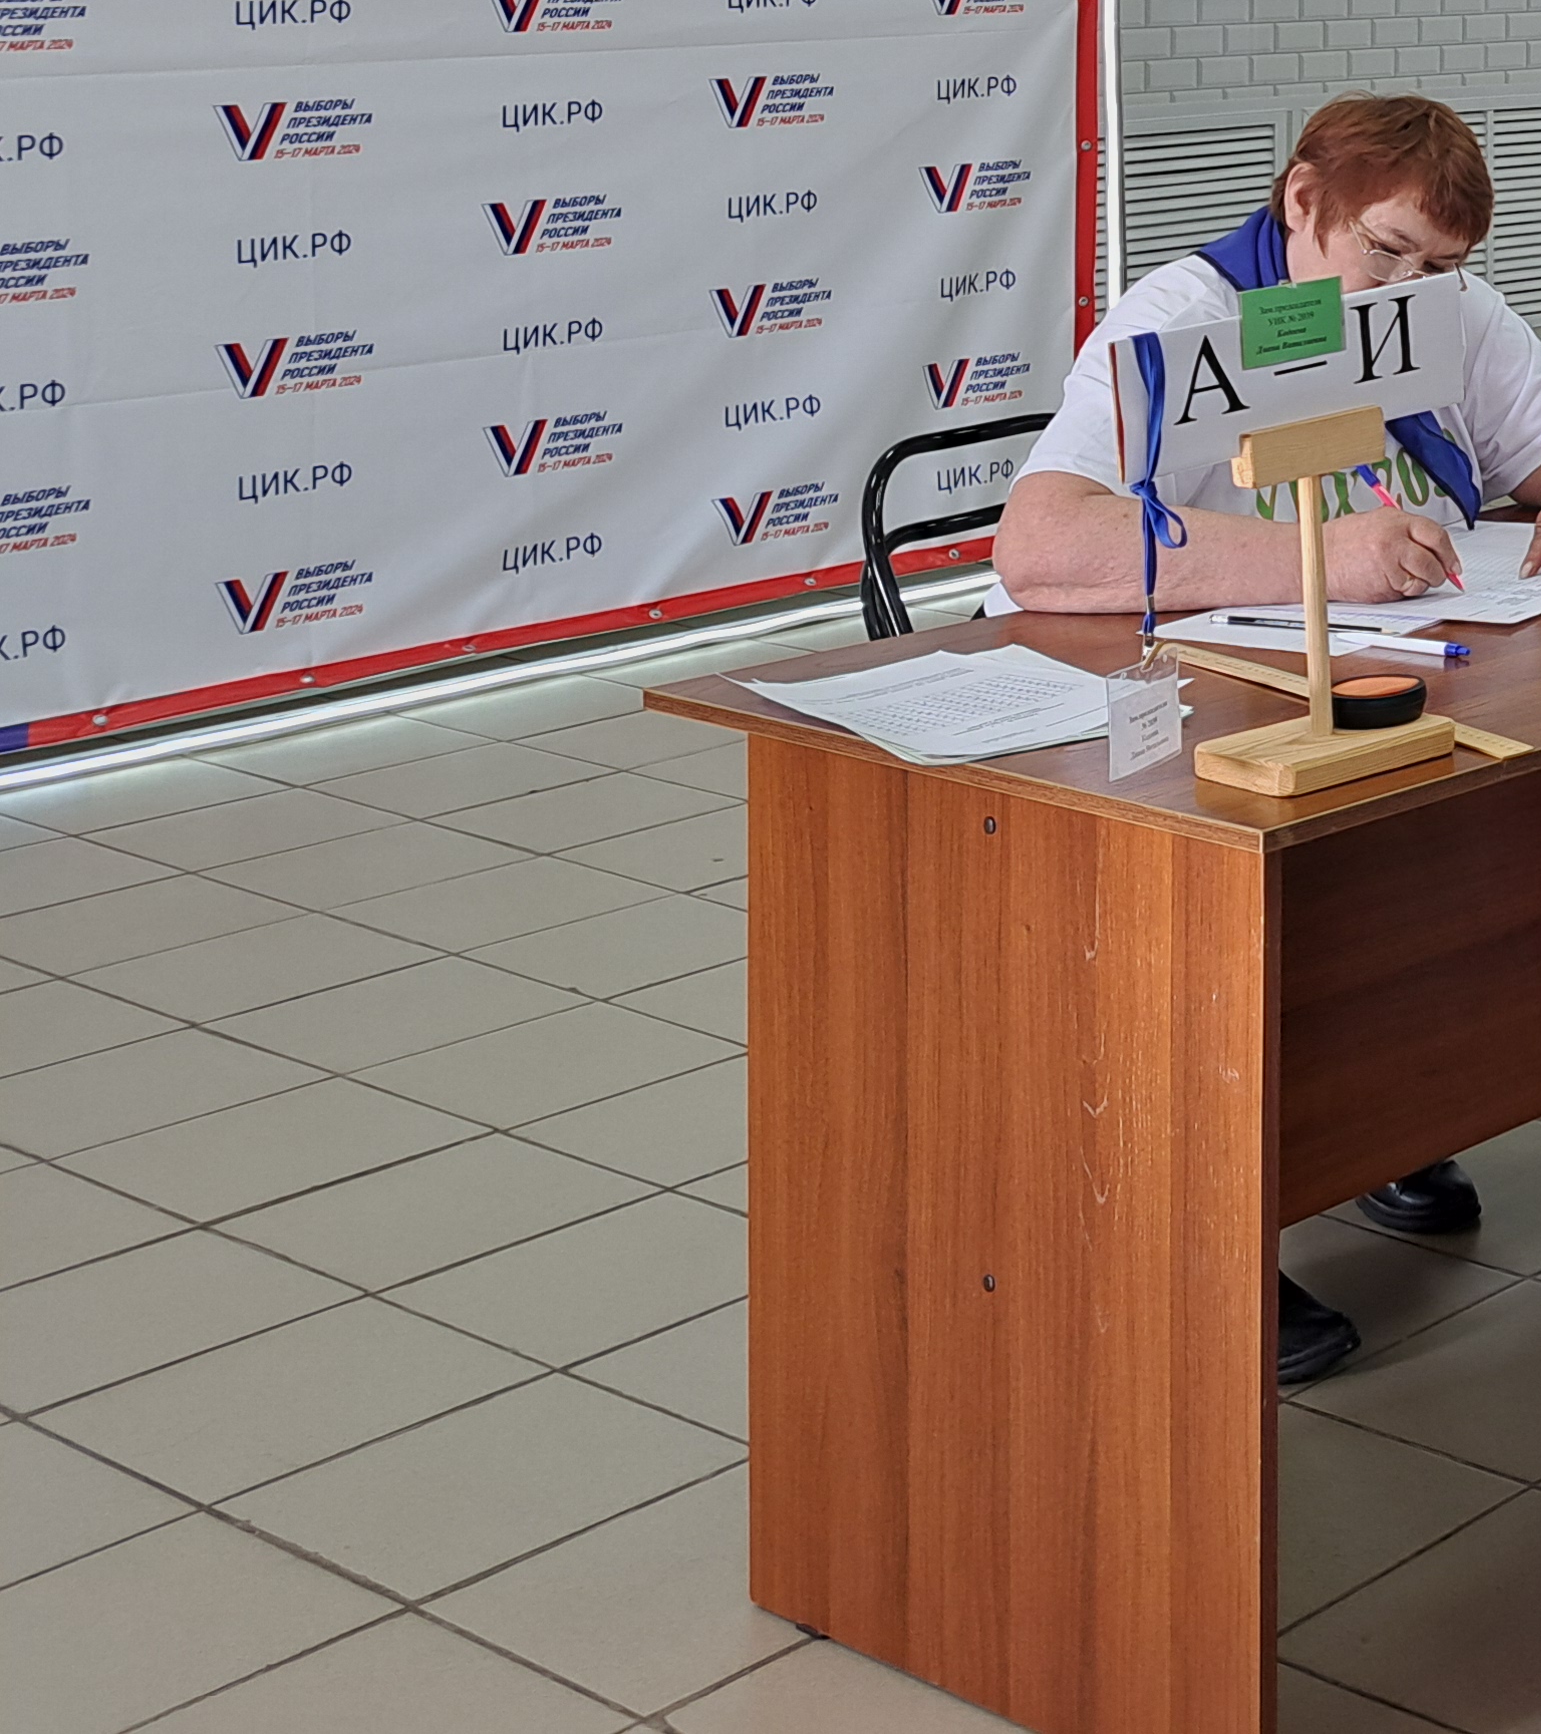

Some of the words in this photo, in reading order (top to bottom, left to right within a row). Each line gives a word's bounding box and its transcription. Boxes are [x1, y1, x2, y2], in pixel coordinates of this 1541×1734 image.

[541, 7, 590, 18] РОССИИ
[772, 73, 820, 85] ВЫБОРЫ
[766, 87, 834, 99] ПРЕЗИДЕНТА
[937, 75, 1016, 104] ЦИК.РФ
[294, 99, 354, 112] ВЫБОРЫ
[761, 102, 804, 114] РОССИИ
[287, 113, 372, 128] ПРЕЗИДЕНТА
[503, 99, 602, 132] ЦИК.РФ
[280, 131, 335, 144] РОССИИ
[977, 159, 1022, 172] ВЫБОРЫ
[974, 172, 1031, 185] ПРЕЗИДЕНТА
[552, 194, 606, 208] ВЫБОРЫ
[969, 187, 1009, 199] РОССИИ
[728, 190, 817, 222] ЦИК.РФ
[546, 208, 622, 224] ПРЕЗИДЕНТА
[540, 225, 589, 239] РОССИИ
[0, 238, 70, 256] ВЫБОРЫ
[238, 230, 351, 268] ЦИК.РФ
[771, 278, 818, 293] ВЫБОРЫ
[941, 269, 1016, 302] ЦИК.РФ
[766, 290, 831, 307] ПРЕЗИДЕНТА
[760, 307, 803, 321] РОССИИ
[295, 330, 356, 347] ВЫБОРЫ
[503, 318, 602, 355] ЦИК.РФ
[288, 344, 374, 363] ПРЕЗИДЕНТА
[975, 352, 1019, 366] ВЫБОРЫ
[1174, 334, 1251, 426] А
[1349, 294, 1421, 384] И
[281, 364, 336, 380] РОССИИ
[970, 364, 1032, 380] ПРЕЗИДЕНТА
[965, 380, 1005, 393] РОССИИ
[553, 410, 607, 428] ВЫБОРЫ
[725, 394, 820, 431] ЦИК.РФ
[547, 423, 623, 443] ПРЕЗИДЕНТА
[541, 442, 590, 459] РОССИИ
[239, 461, 352, 504] ЦИК.РФ
[937, 458, 1013, 494] ЦИК.РФ
[1, 485, 72, 506] ВЫБОРЫ
[777, 482, 824, 499] ВЫБОРЫ
[771, 493, 838, 513] ПРЕЗИДЕНТА
[766, 512, 809, 528] РОССИИ
[503, 533, 602, 574] ЦИК.РФ
[295, 559, 355, 580] ВЫБОРЫ
[288, 572, 373, 596] ПРЕЗИДЕНТА
[281, 594, 336, 613] РОССИИ
